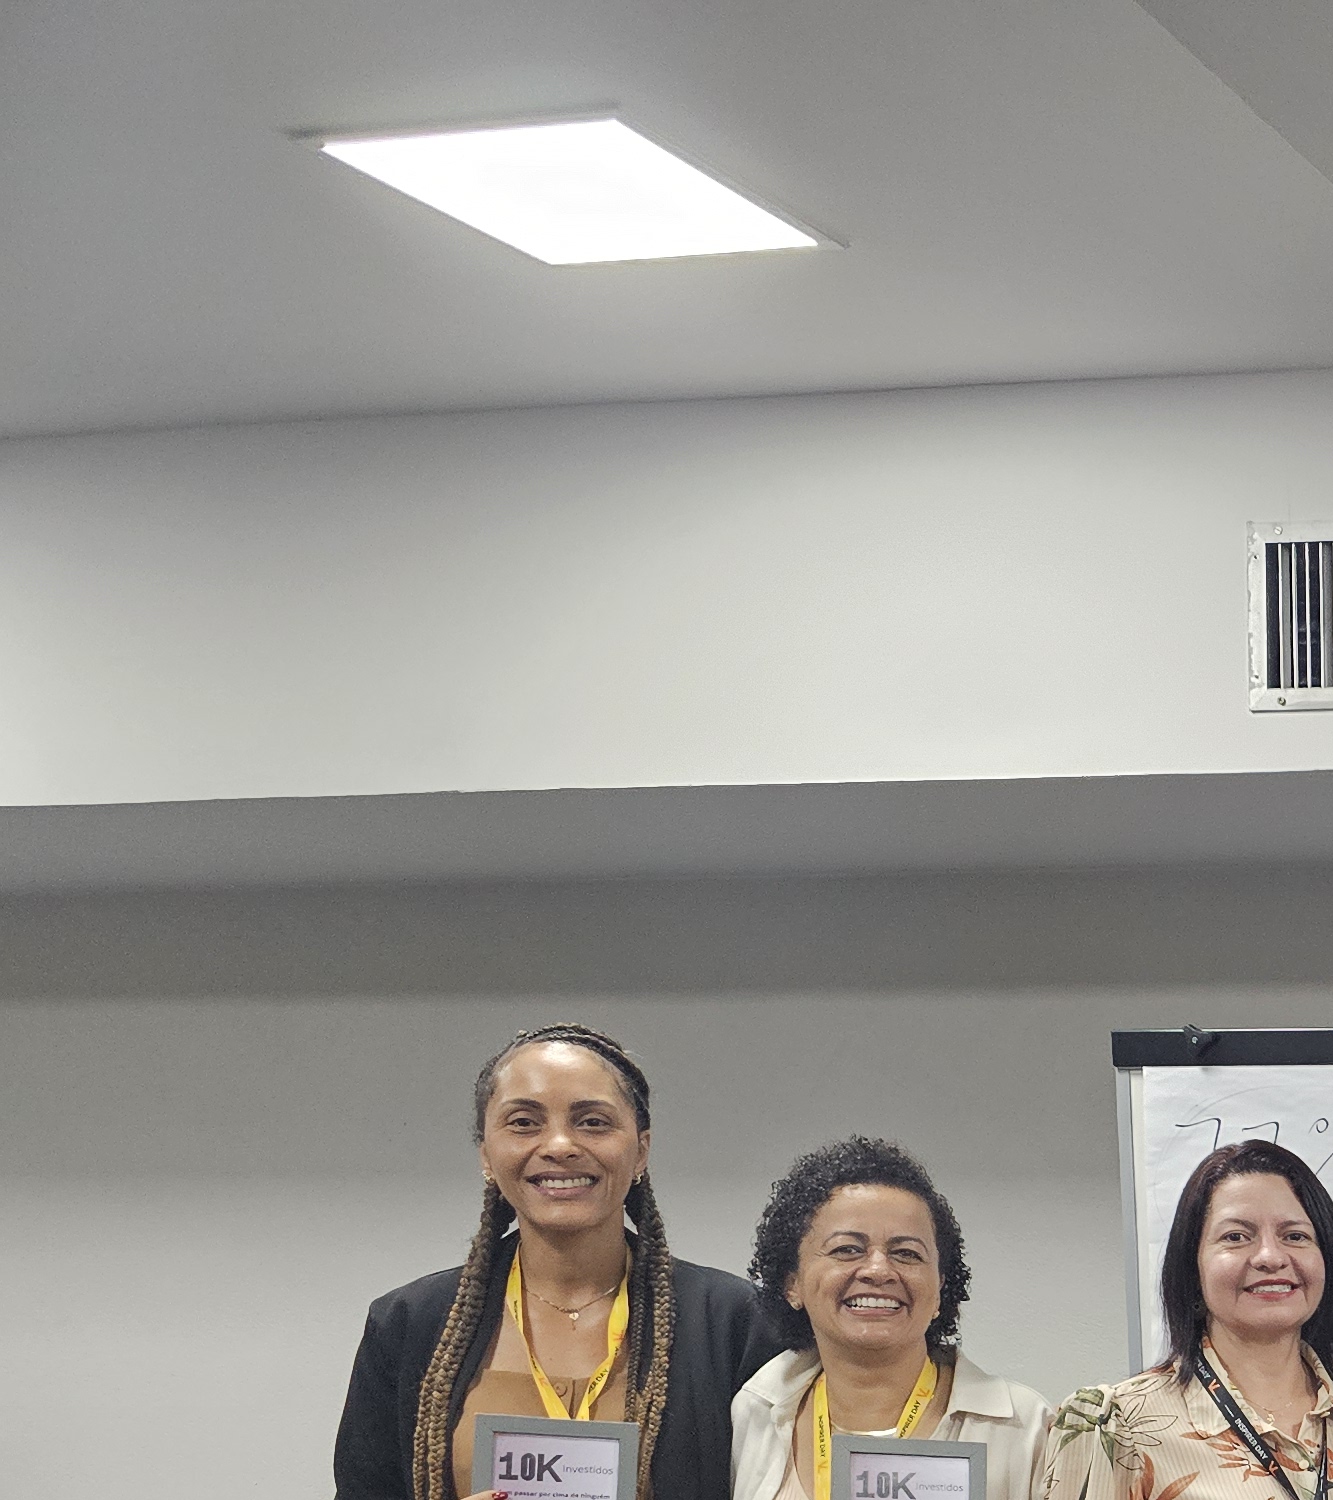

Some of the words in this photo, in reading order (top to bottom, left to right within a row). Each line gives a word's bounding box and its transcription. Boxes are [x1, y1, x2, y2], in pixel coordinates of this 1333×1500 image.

[911, 1400, 921, 1415] DAY
[1235, 1418, 1257, 1447] INSPIRER
[1255, 1445, 1268, 1459] DAY
[499, 1452, 563, 1483] 10K
[563, 1465, 613, 1475] Investidos
[856, 1470, 916, 1500] 10K
[915, 1483, 963, 1492] Investidos
